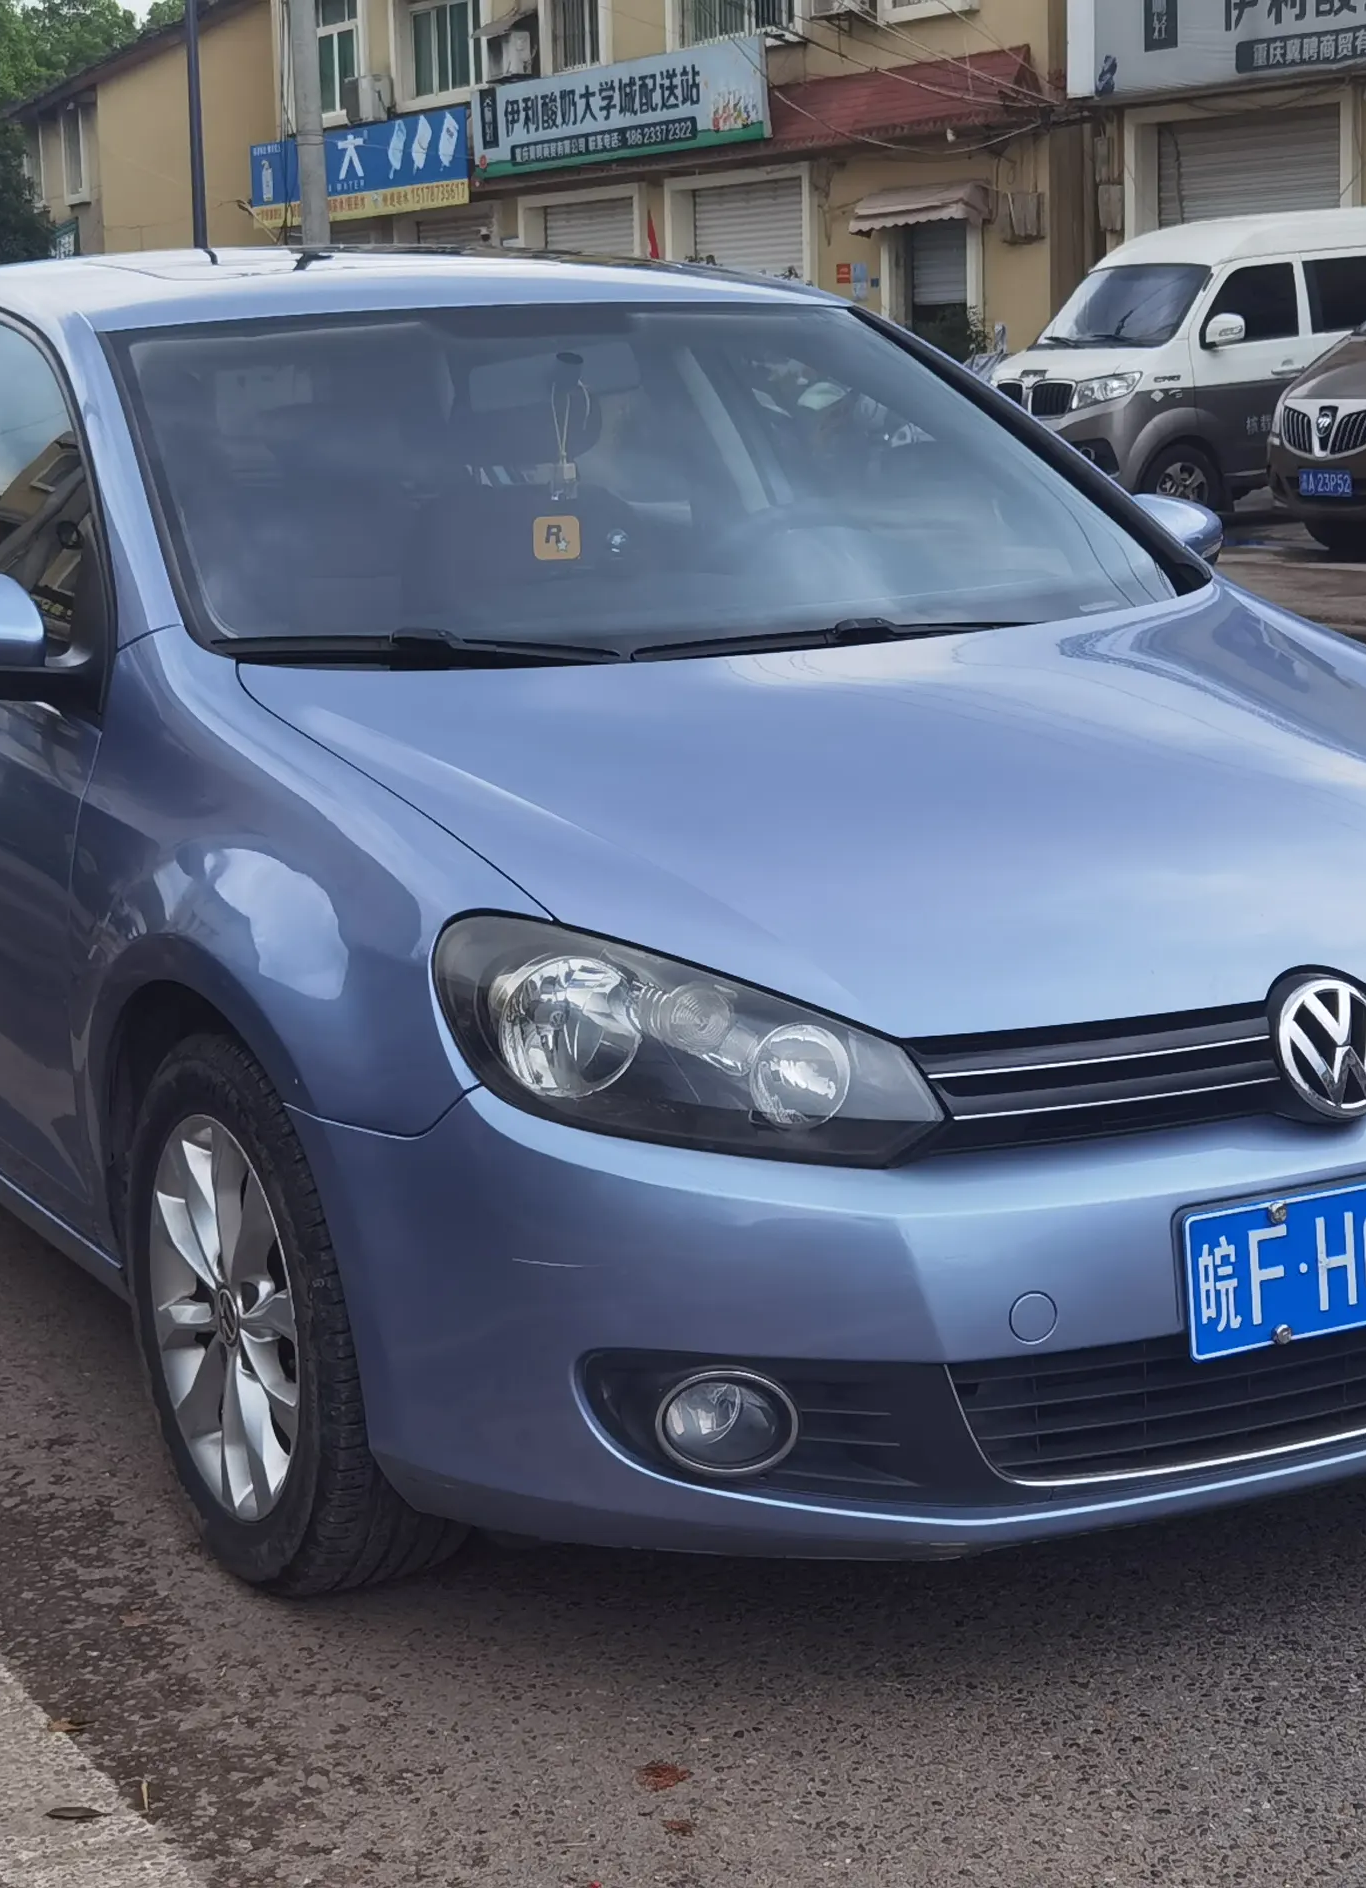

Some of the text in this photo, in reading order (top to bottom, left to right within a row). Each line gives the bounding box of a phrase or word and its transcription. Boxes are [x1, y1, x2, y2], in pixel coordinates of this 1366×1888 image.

[504, 64, 701, 138] 伊利酸奶大学城配送站
[626, 129, 643, 146] 186
[643, 125, 667, 143] 2337
[668, 120, 693, 141] 2322
